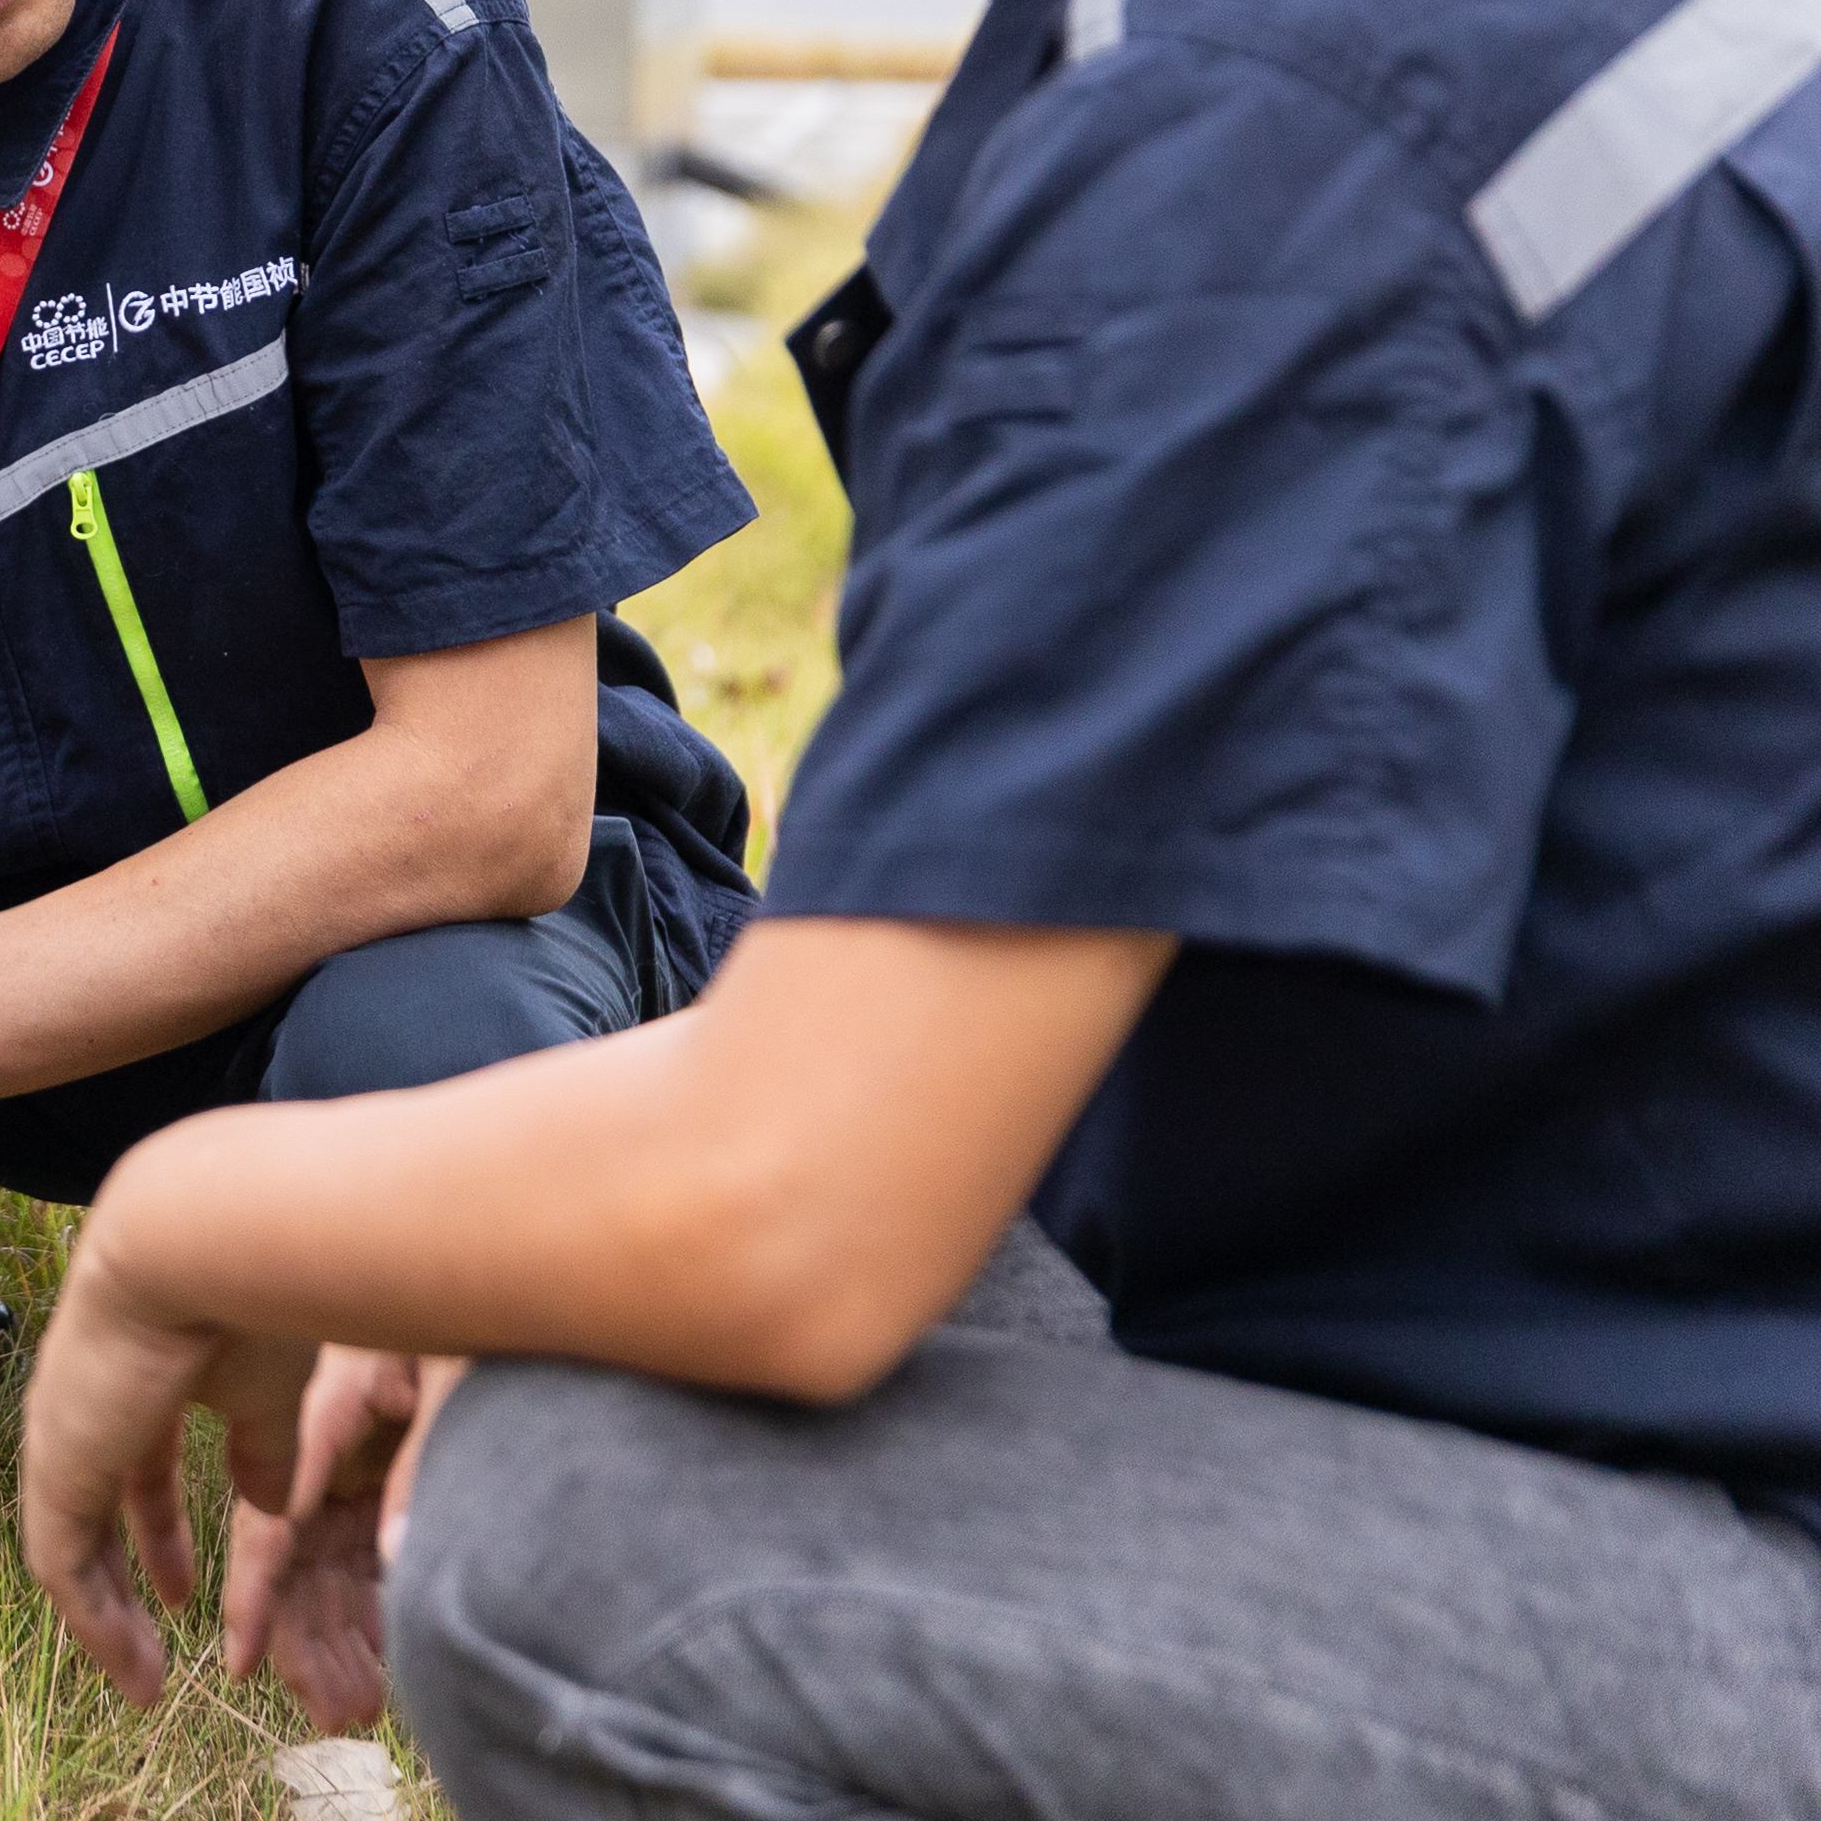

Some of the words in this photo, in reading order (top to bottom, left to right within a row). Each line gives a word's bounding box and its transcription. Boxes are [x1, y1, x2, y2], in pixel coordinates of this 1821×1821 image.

[159, 256, 299, 318] 中节能国祯
[20, 316, 109, 354] 中国节能
[29, 338, 106, 371] CECEP
